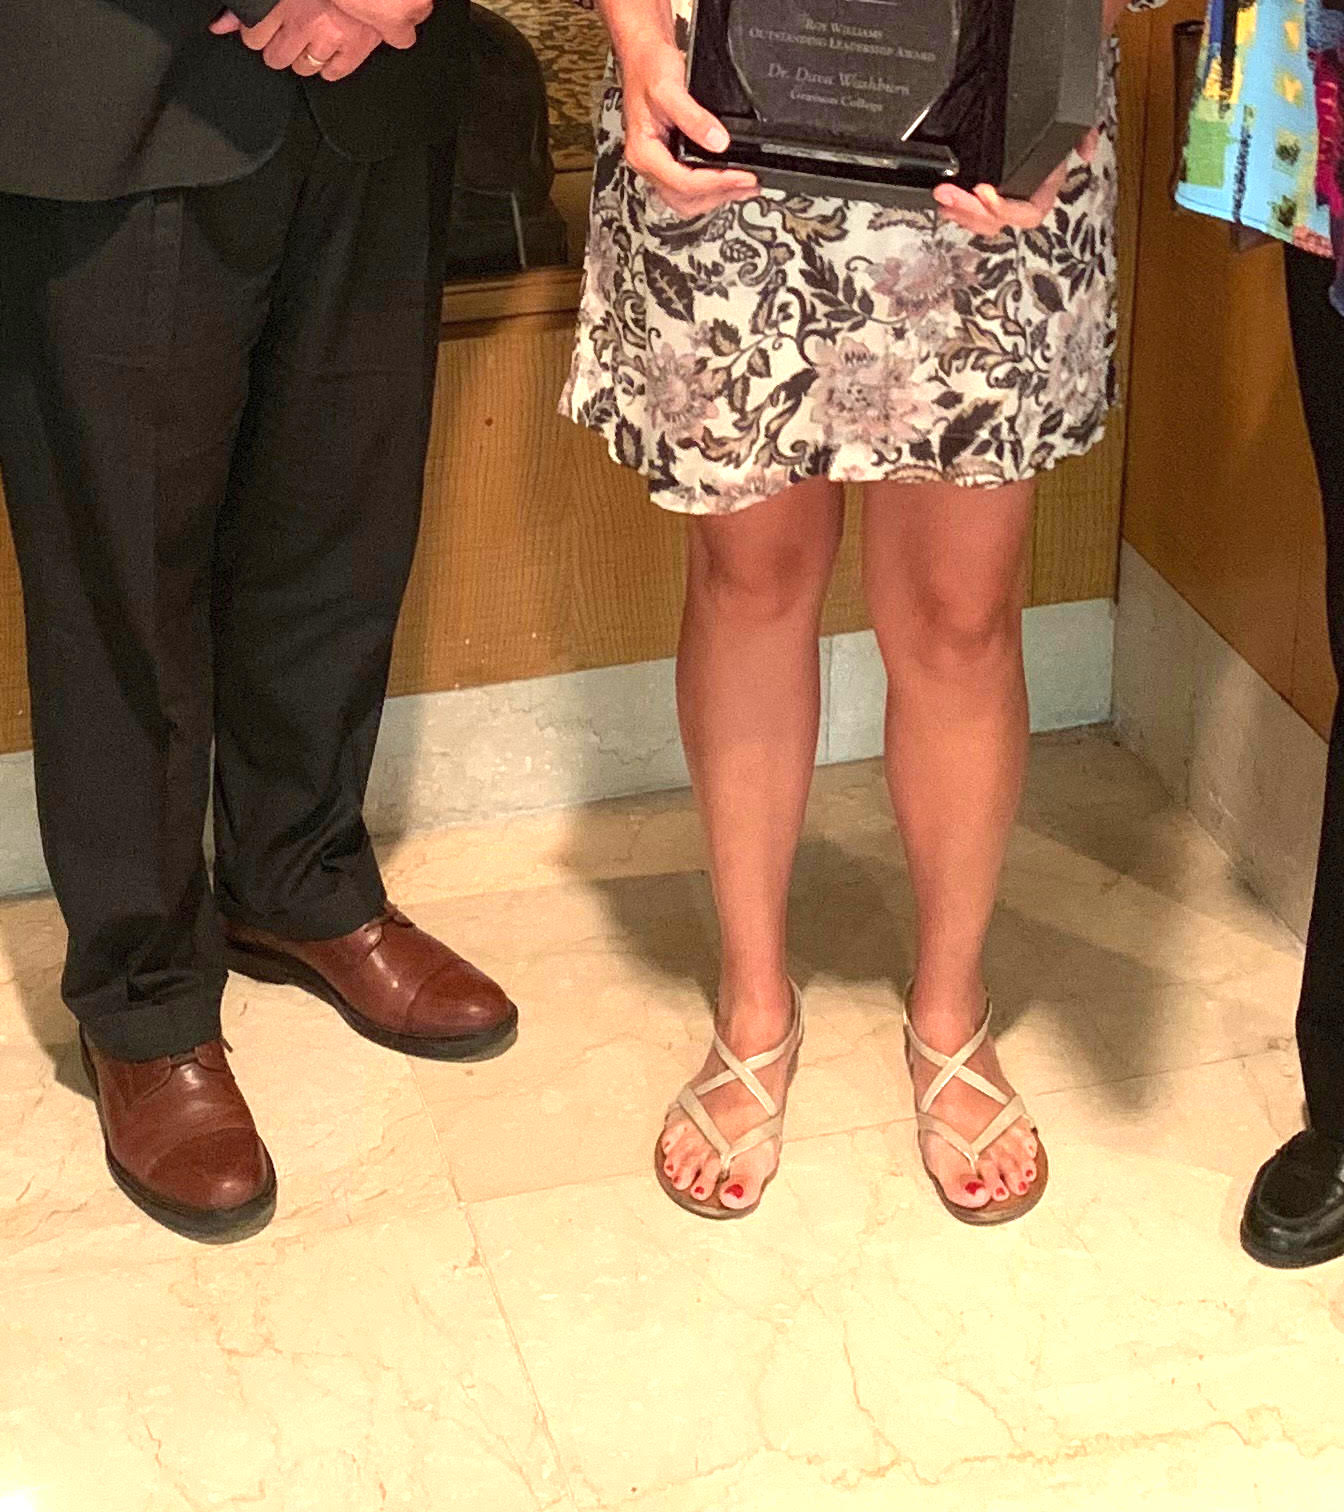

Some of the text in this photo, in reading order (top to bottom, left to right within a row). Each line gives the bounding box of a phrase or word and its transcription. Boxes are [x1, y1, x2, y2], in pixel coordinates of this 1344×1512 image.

[768, 62, 791, 80] Dr.
[838, 71, 911, 96] Washburn
[839, 95, 884, 112] College
